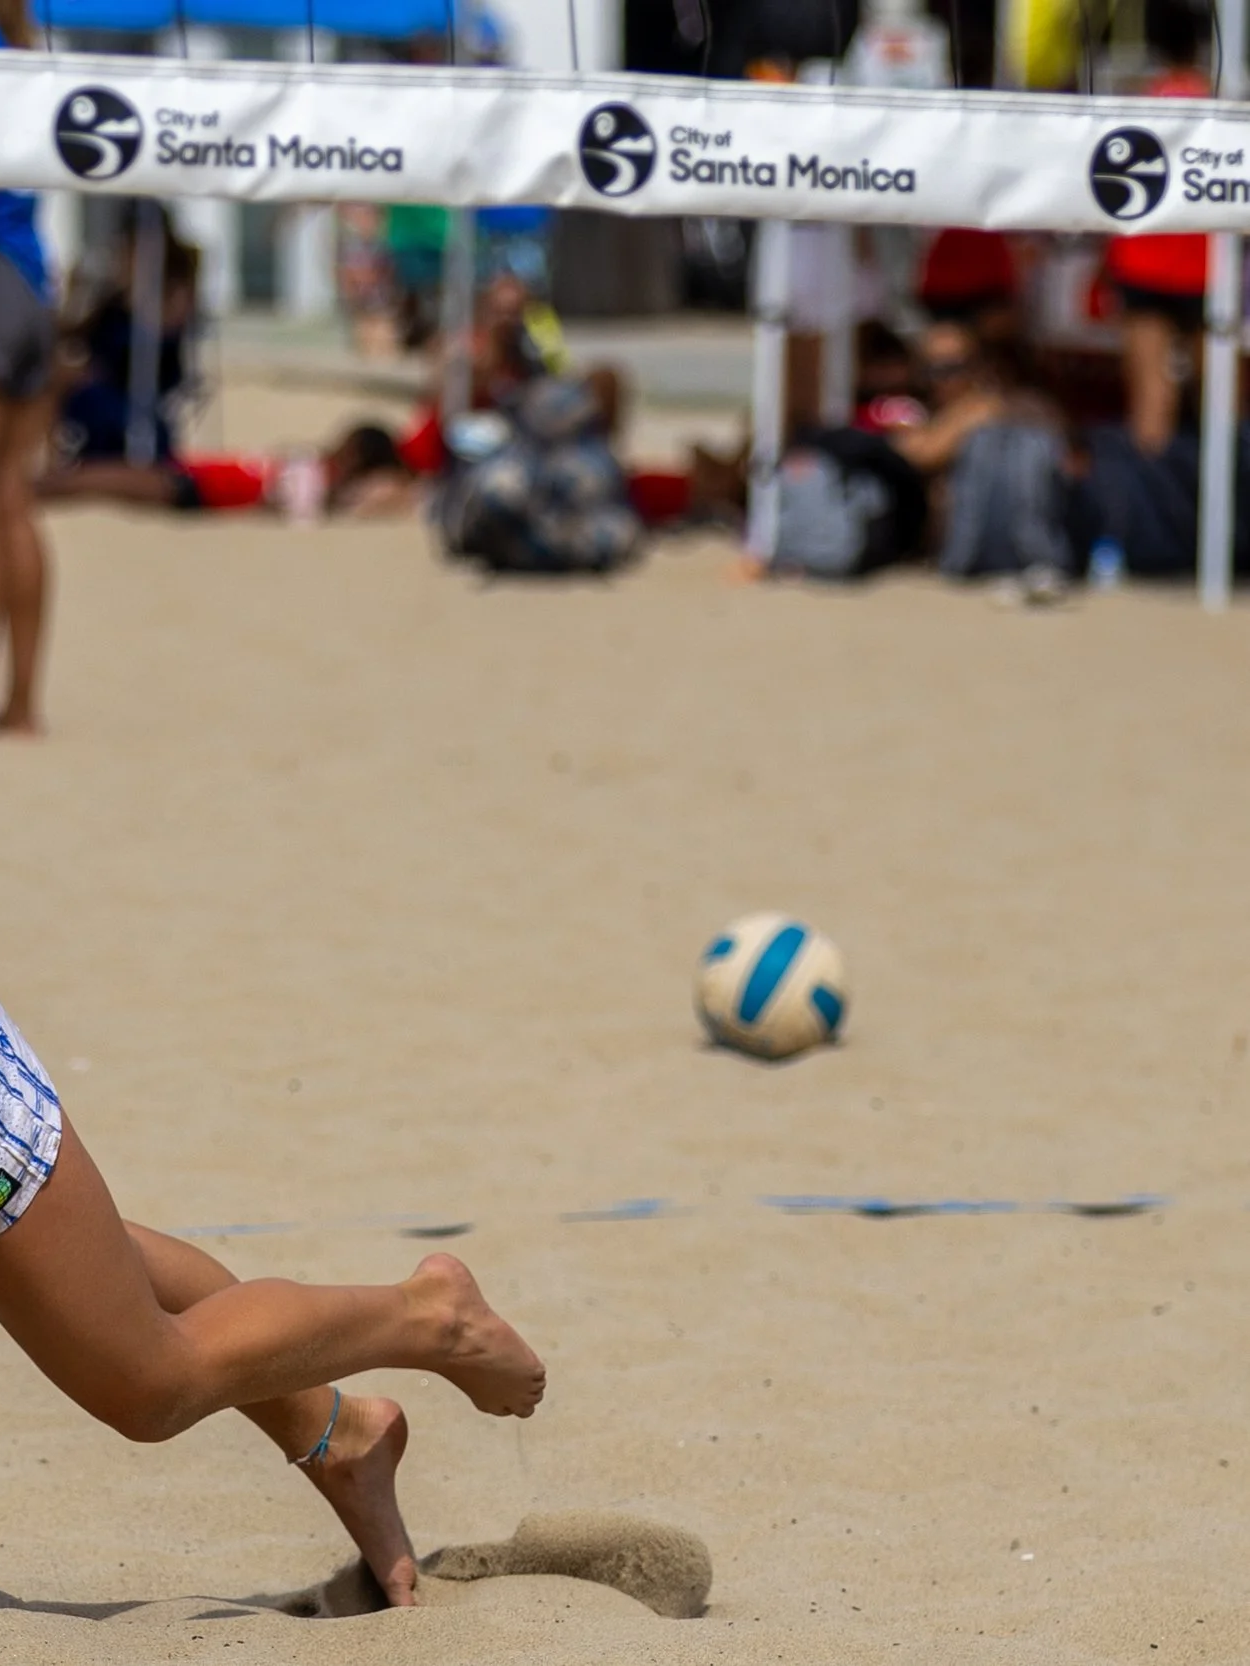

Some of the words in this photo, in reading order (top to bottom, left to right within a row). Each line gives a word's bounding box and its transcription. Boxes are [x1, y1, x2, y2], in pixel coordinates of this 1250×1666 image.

[155, 107, 196, 130] City
[201, 109, 220, 127] of
[157, 130, 256, 168] Santa
[268, 134, 403, 172] Monica
[669, 125, 710, 150] City
[714, 130, 732, 147] of
[670, 147, 776, 187] Santa
[787, 153, 915, 192] Monica
[1181, 147, 1222, 170] City
[1225, 148, 1244, 166] of
[1183, 168, 1250, 202] San
